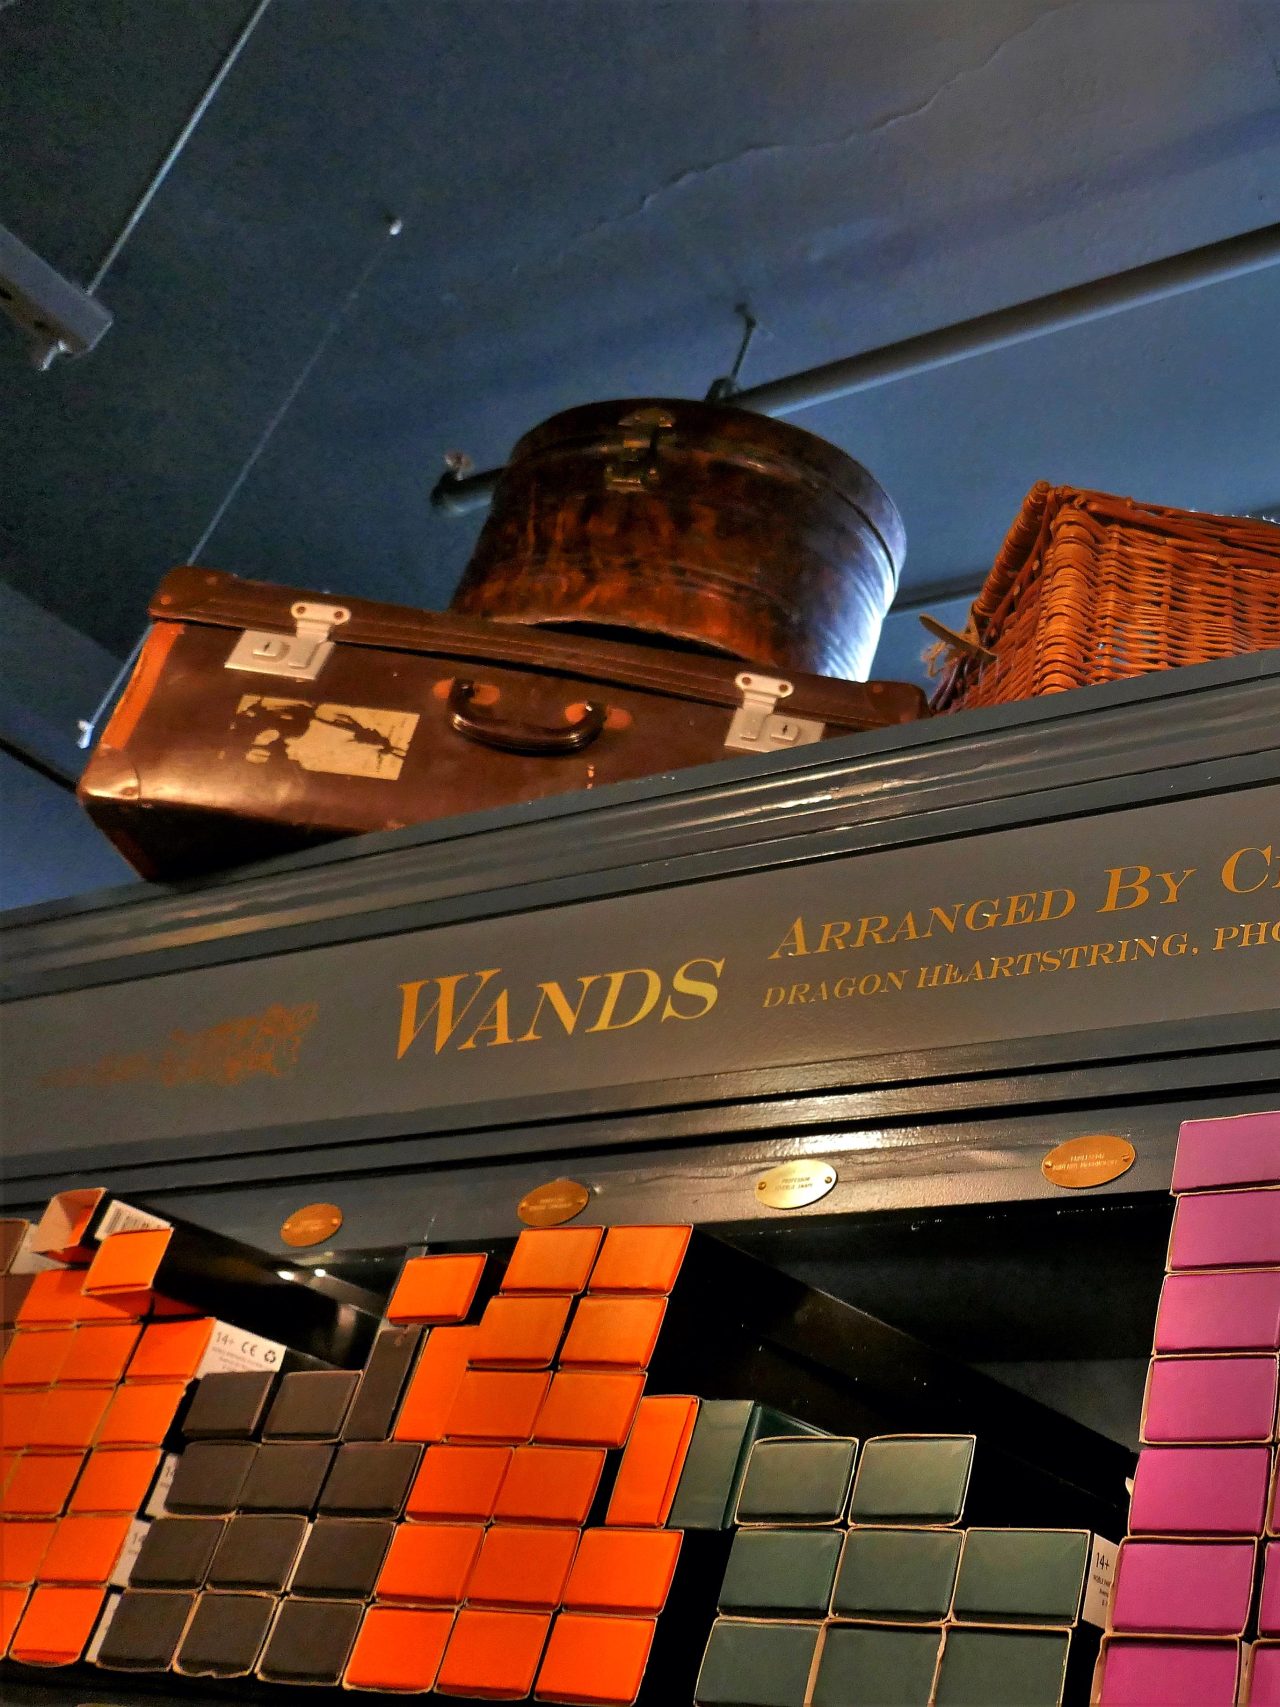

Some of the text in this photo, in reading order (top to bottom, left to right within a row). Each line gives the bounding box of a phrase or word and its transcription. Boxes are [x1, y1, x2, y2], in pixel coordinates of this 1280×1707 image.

[768, 888, 1076, 960] ARRANGED
[1096, 865, 1197, 914] BY
[397, 957, 726, 1060] WANDS
[762, 969, 909, 1009] DRAGON
[1096, 1552, 1110, 1570] 14+
